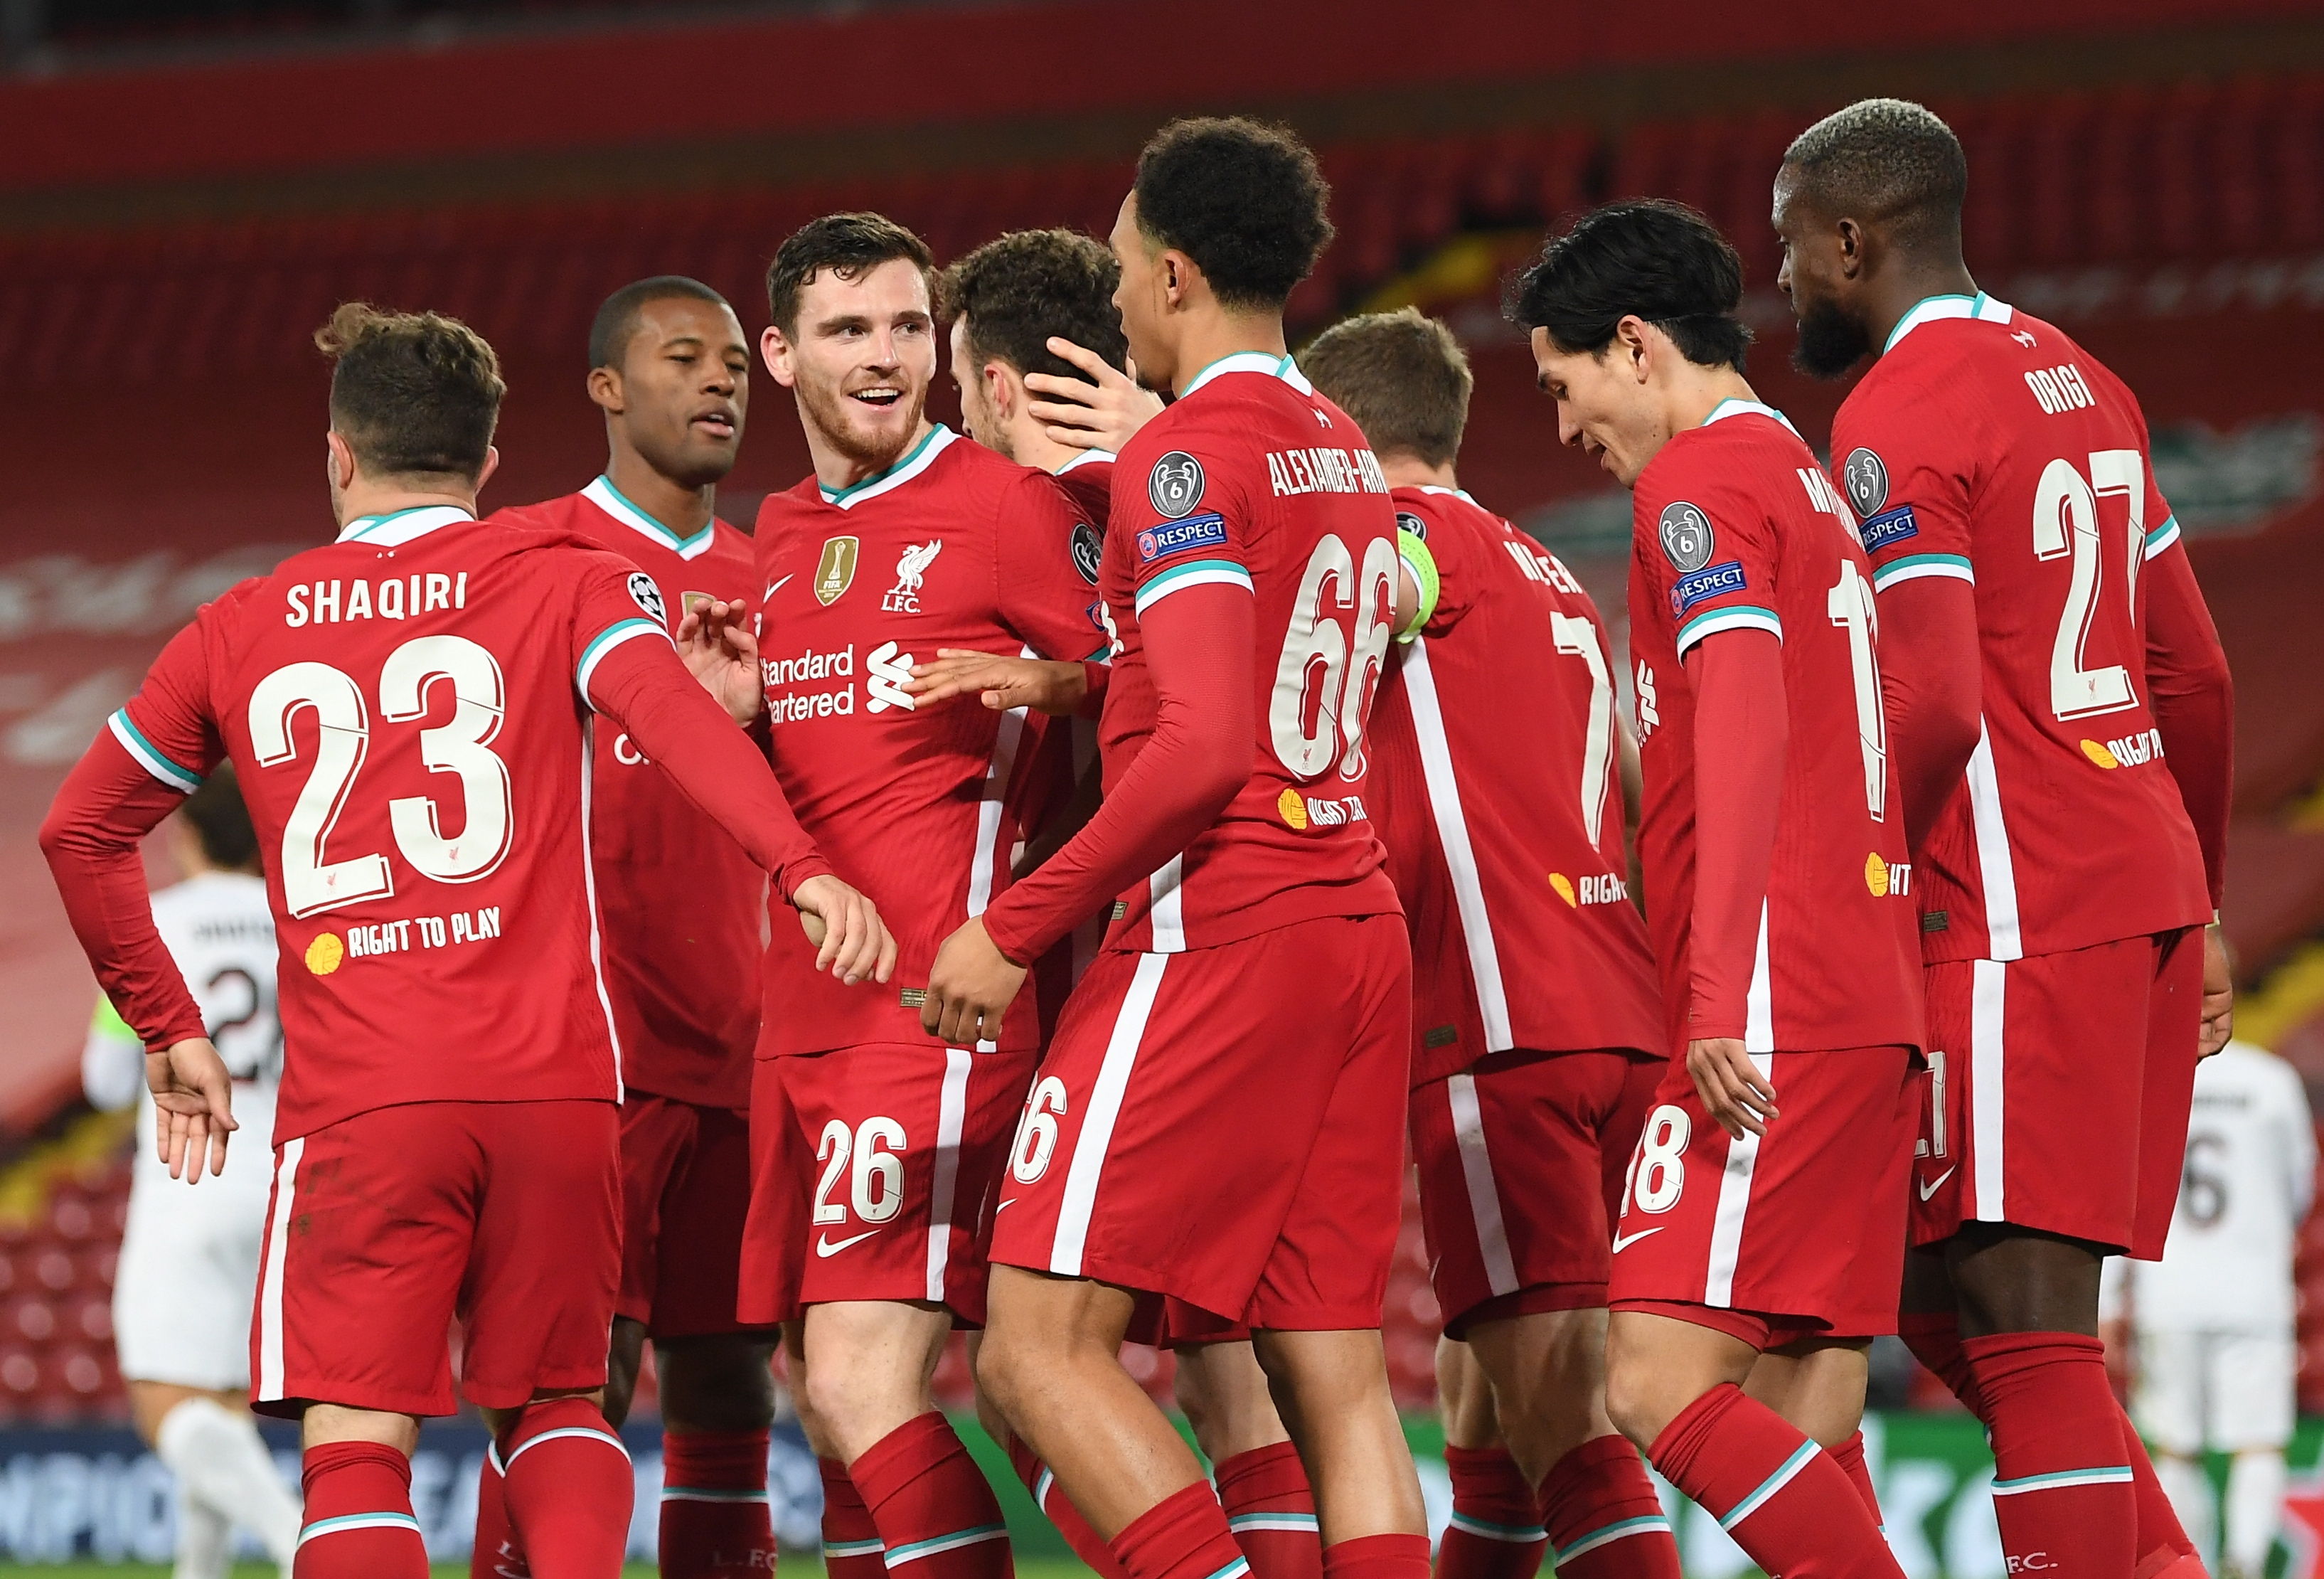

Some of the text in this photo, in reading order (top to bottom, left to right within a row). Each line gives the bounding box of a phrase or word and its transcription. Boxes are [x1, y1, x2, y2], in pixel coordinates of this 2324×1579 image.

[2025, 363, 2096, 415] ORIGI
[1168, 482, 1183, 500] 6
[1266, 447, 1390, 496] ALEXANDER-ARN
[1860, 482, 1870, 499] 6
[1156, 520, 1225, 548] RESPECT
[1679, 535, 1694, 553] 6
[1862, 514, 1914, 546] RESPECT
[285, 572, 468, 627] SHAQIRI
[880, 595, 921, 613] L.F.C.
[1680, 568, 1742, 600] RESPECT
[2033, 450, 2145, 722] 27
[1269, 533, 1400, 782] 66
[767, 683, 854, 724] artered
[1828, 559, 1887, 823] 1
[1550, 611, 1614, 854] 7
[248, 635, 514, 919] 23
[347, 906, 501, 958] RIGHT TO PLAY
[206, 966, 272, 1083] 2
[812, 1116, 907, 1226] 26
[2180, 1132, 2232, 1234] 6
